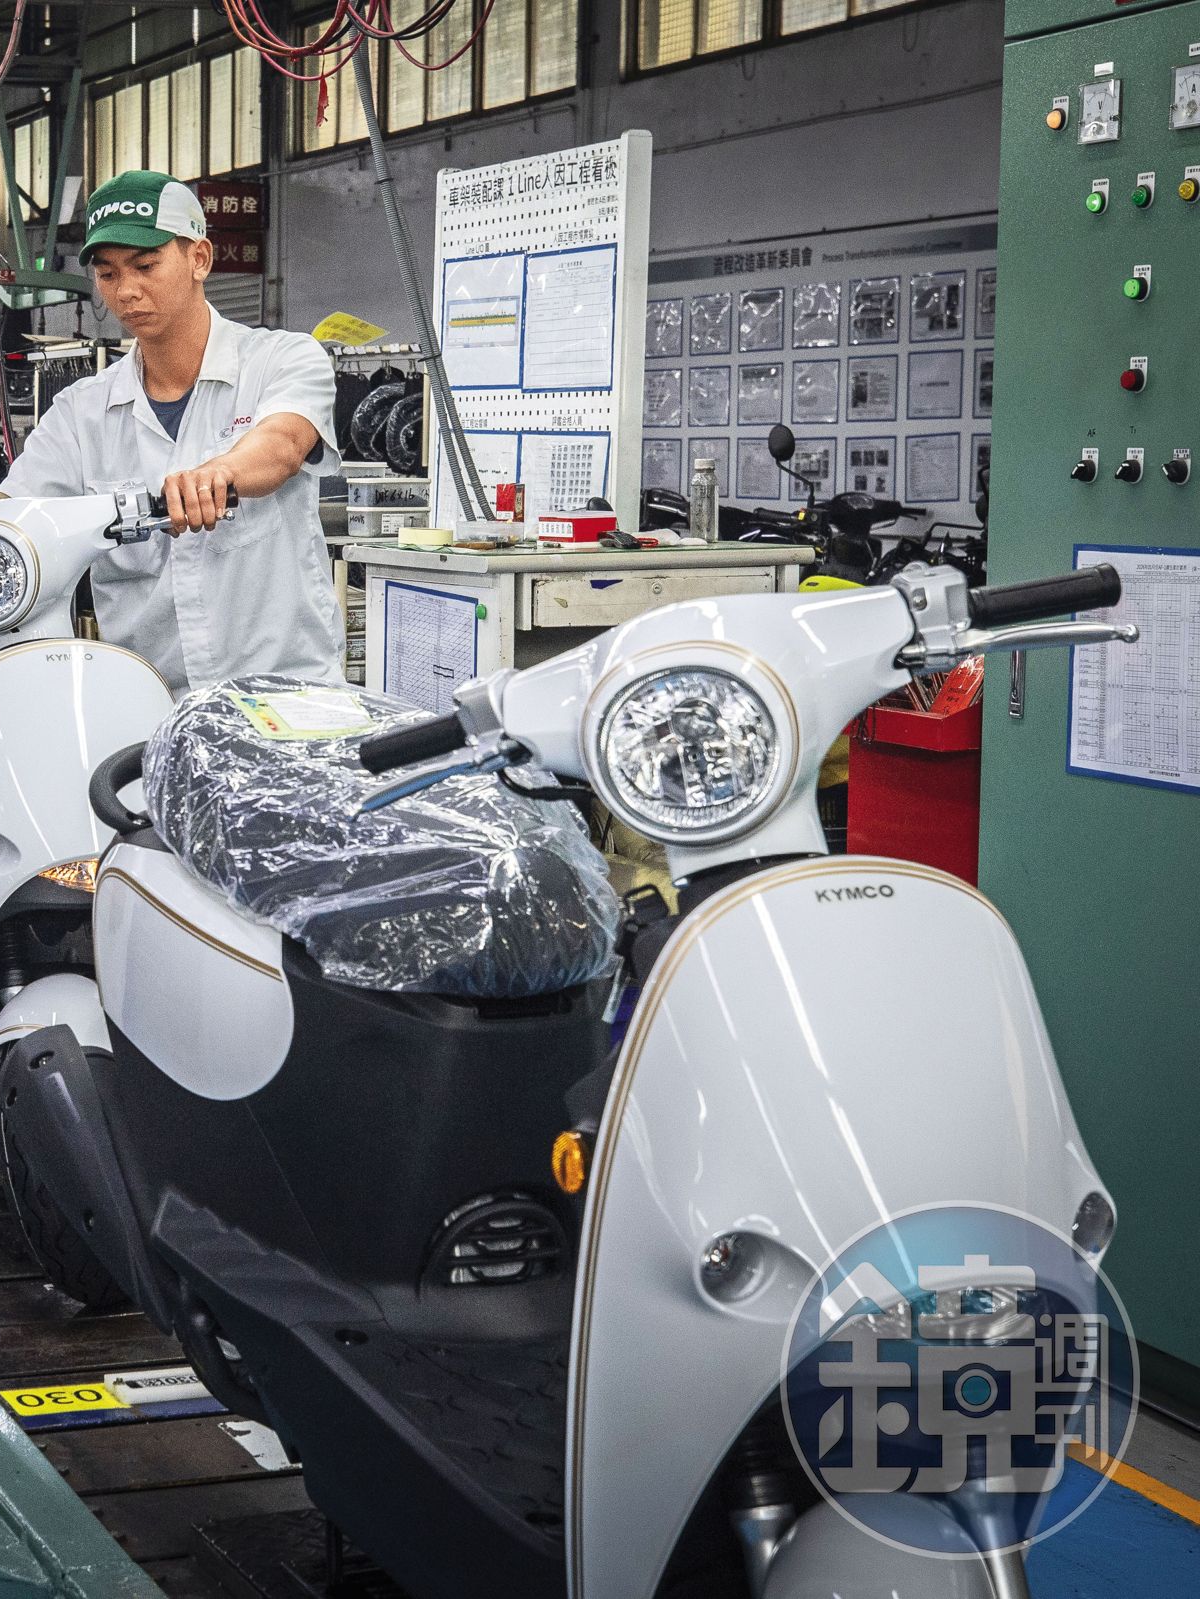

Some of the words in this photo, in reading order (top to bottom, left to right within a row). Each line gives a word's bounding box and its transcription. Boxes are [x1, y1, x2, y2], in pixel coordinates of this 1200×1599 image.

[508, 176, 515, 197] 1
[202, 196, 258, 213] 消防栓
[88, 200, 154, 230] KYMCO
[45, 653, 93, 662] KYMO
[814, 884, 895, 903] KYMCO
[15, 1388, 103, 1408] 030
